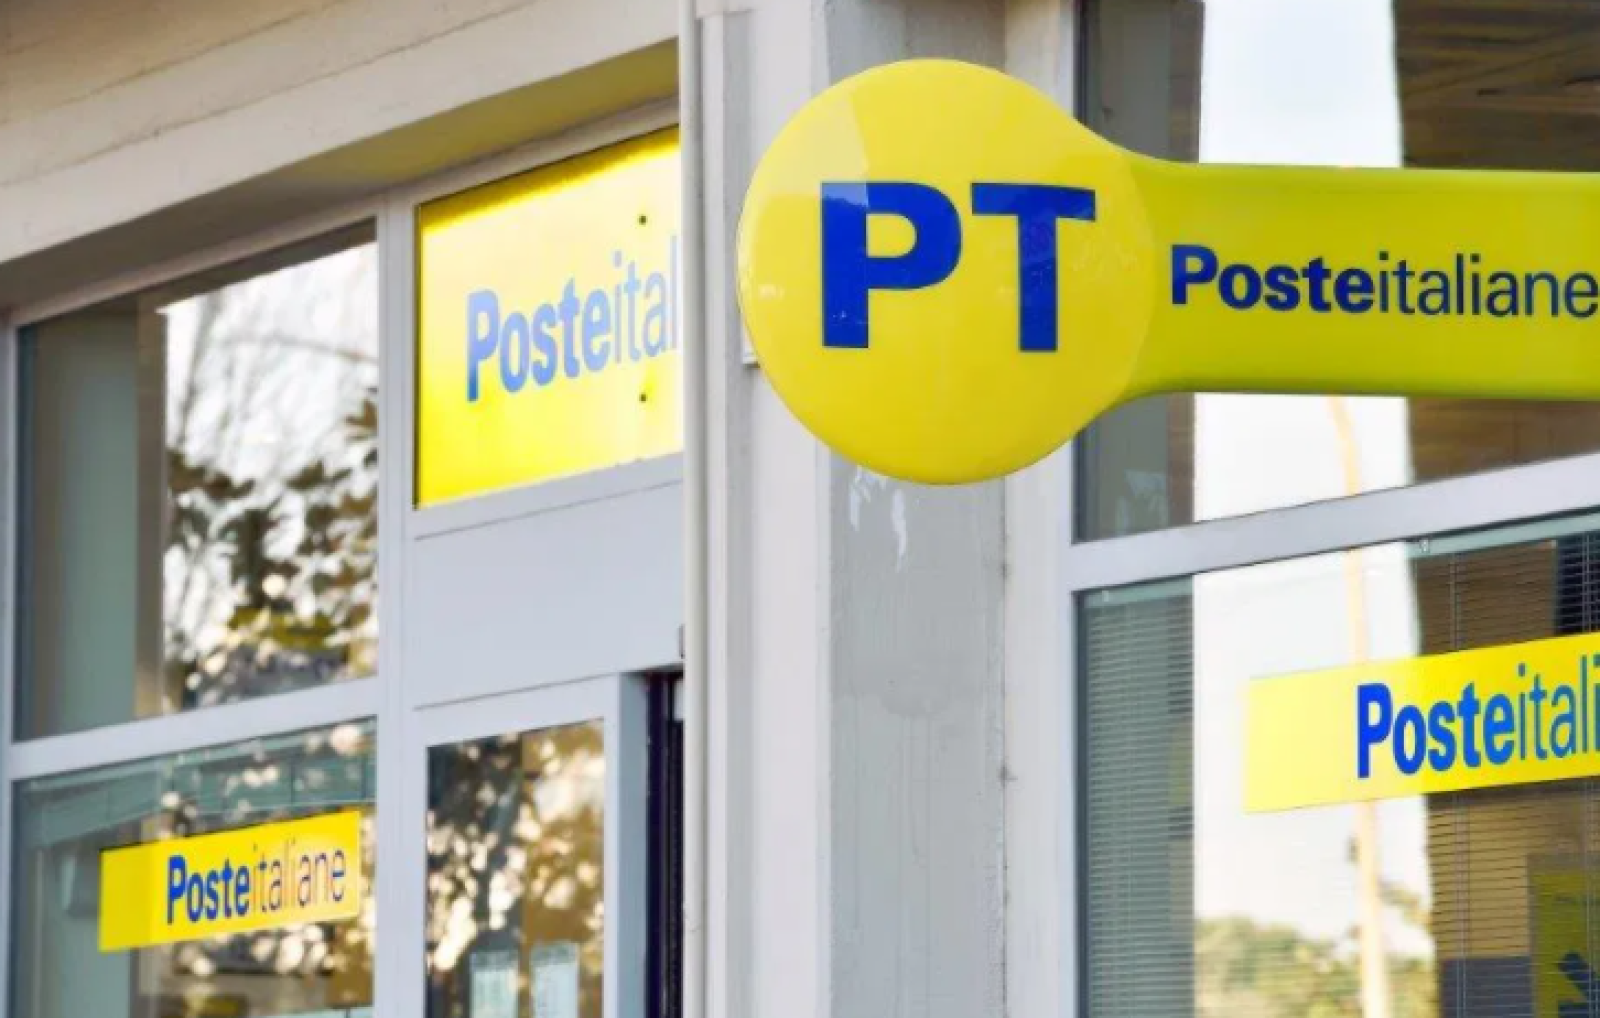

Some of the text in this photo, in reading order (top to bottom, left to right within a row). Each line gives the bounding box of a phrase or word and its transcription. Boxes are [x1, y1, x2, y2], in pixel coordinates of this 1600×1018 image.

[466, 235, 678, 402] Posteital
[821, 182, 1096, 353] PT
[1170, 244, 1599, 319] Posteitaliane
[167, 837, 345, 925] Posteitaliane
